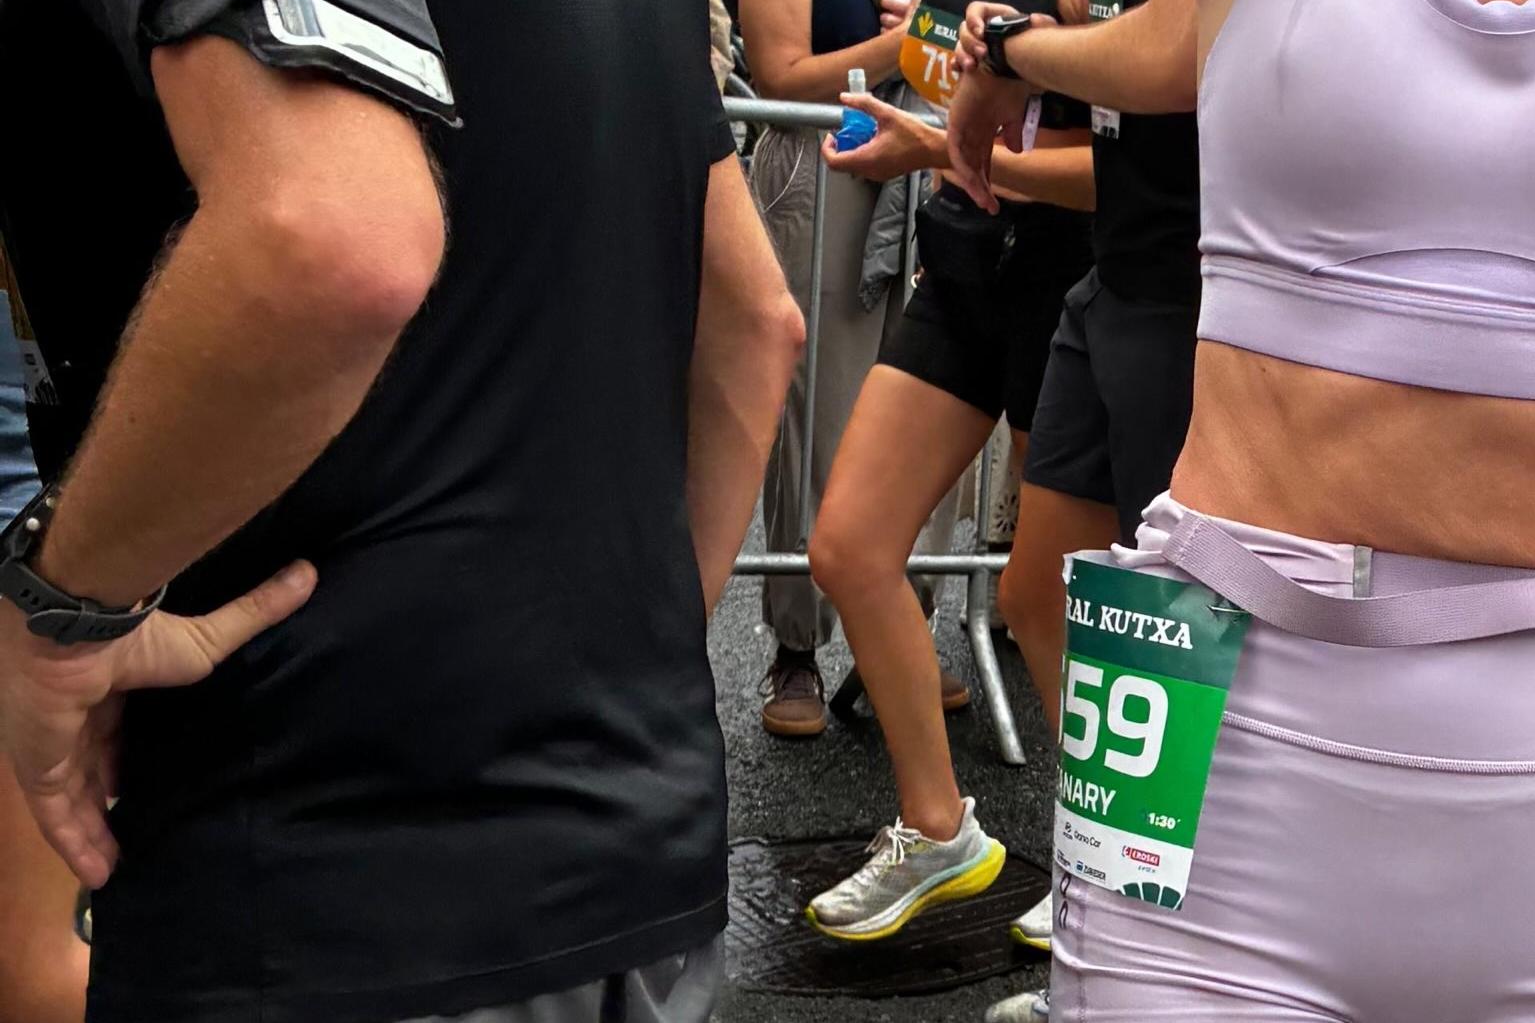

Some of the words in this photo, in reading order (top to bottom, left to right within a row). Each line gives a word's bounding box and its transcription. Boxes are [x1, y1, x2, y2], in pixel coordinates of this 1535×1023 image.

[922, 44, 960, 91] 71
[1098, 604, 1193, 650] KUTXA
[1059, 655, 1169, 778] 59
[1058, 764, 1116, 817] NARY
